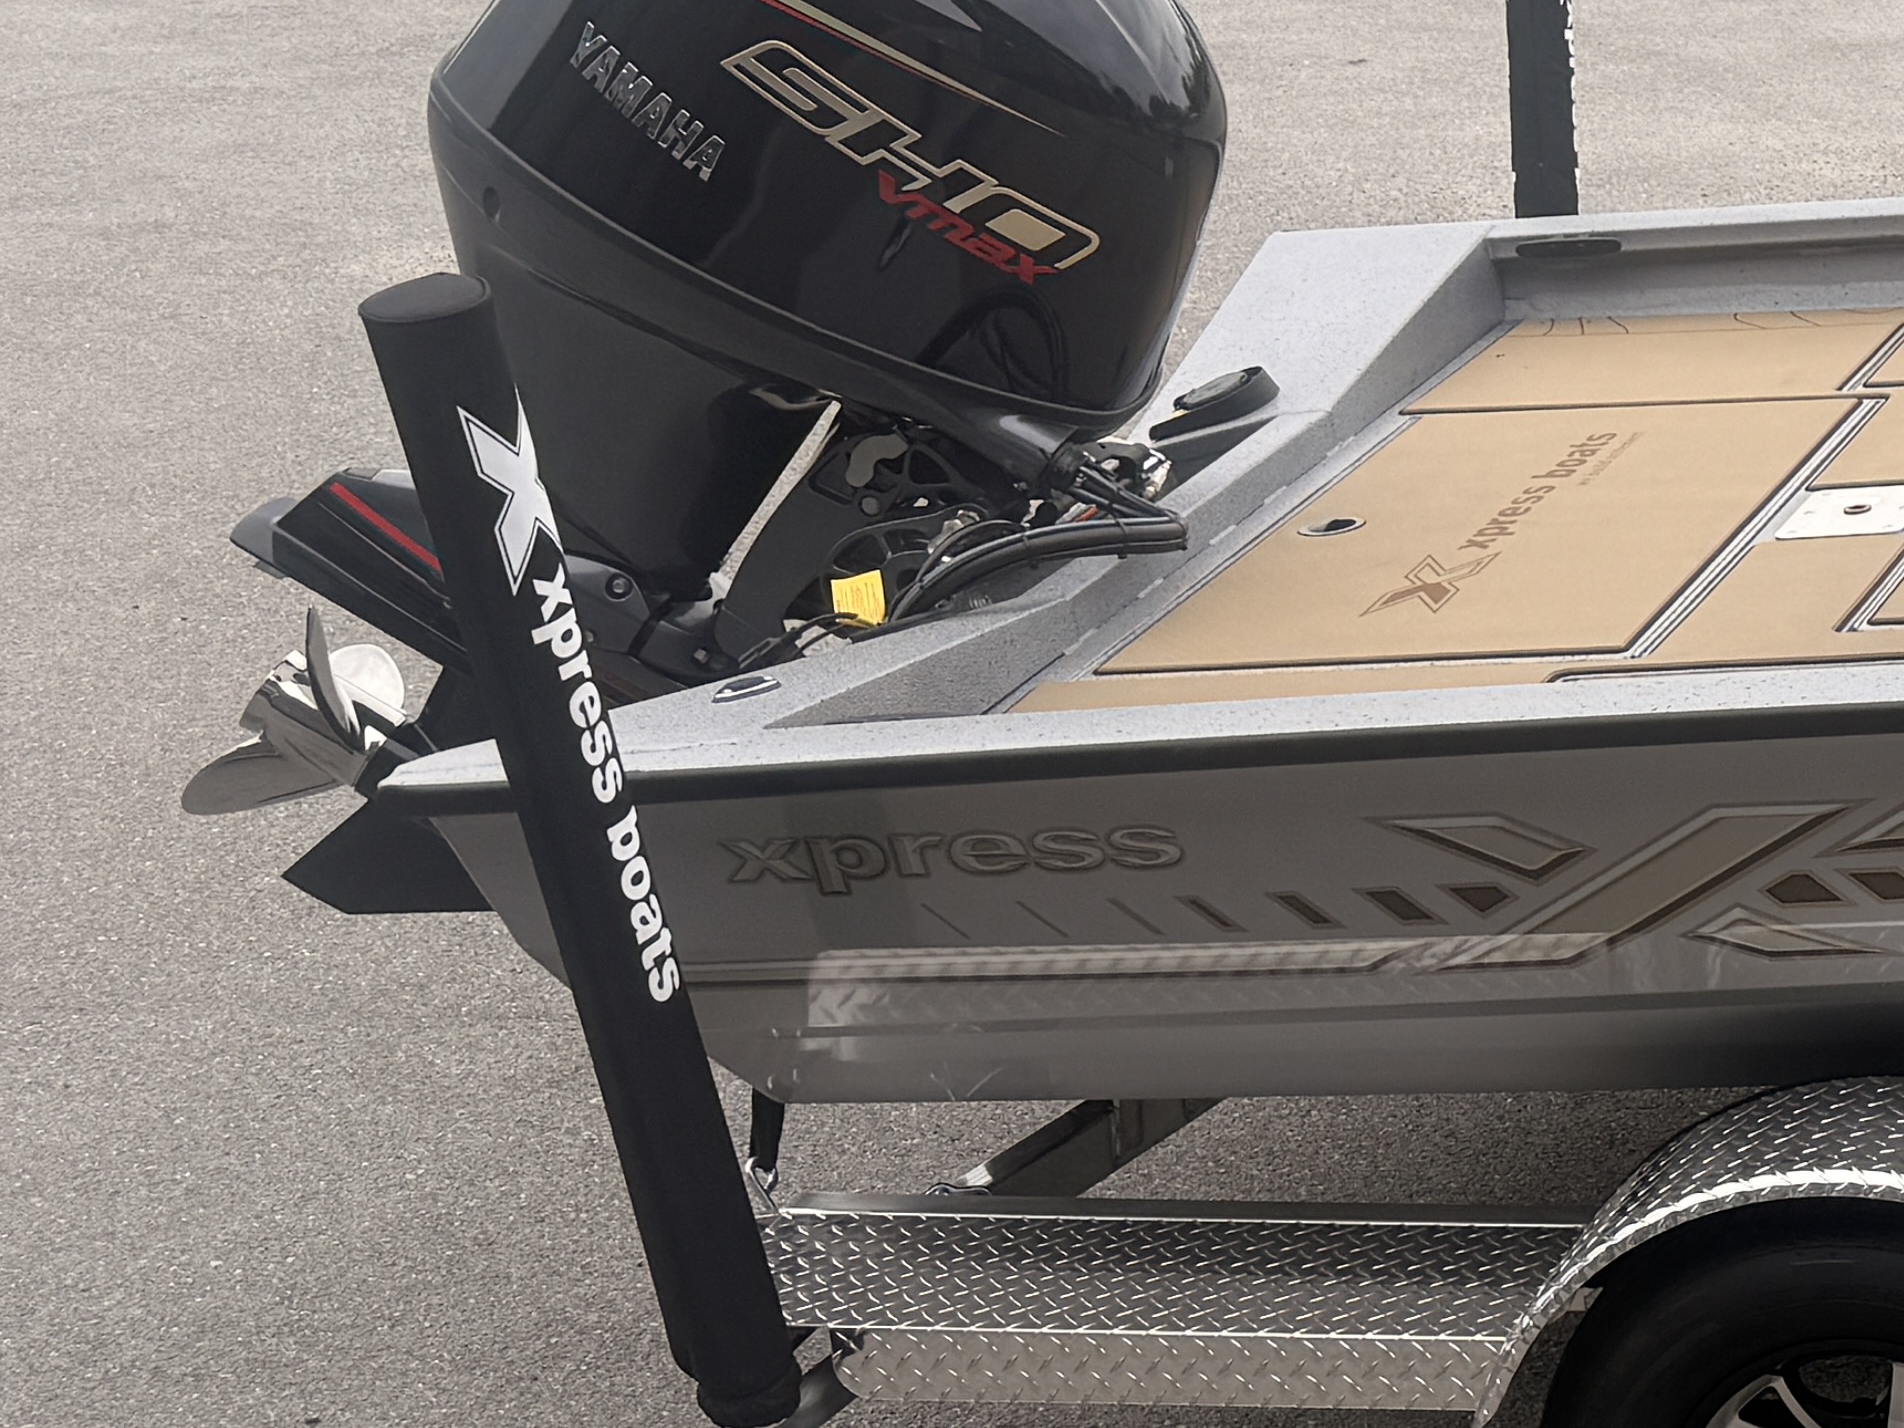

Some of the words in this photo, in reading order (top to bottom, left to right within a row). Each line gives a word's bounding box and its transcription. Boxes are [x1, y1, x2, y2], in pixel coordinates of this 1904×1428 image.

[569, 21, 727, 183] YAMAHA
[720, 39, 1101, 272] SHO
[1457, 484, 1557, 551] xpress
[1530, 432, 1618, 480] boats
[530, 562, 627, 805] xpress
[605, 804, 682, 1004] boats
[718, 824, 1185, 895] xpress
